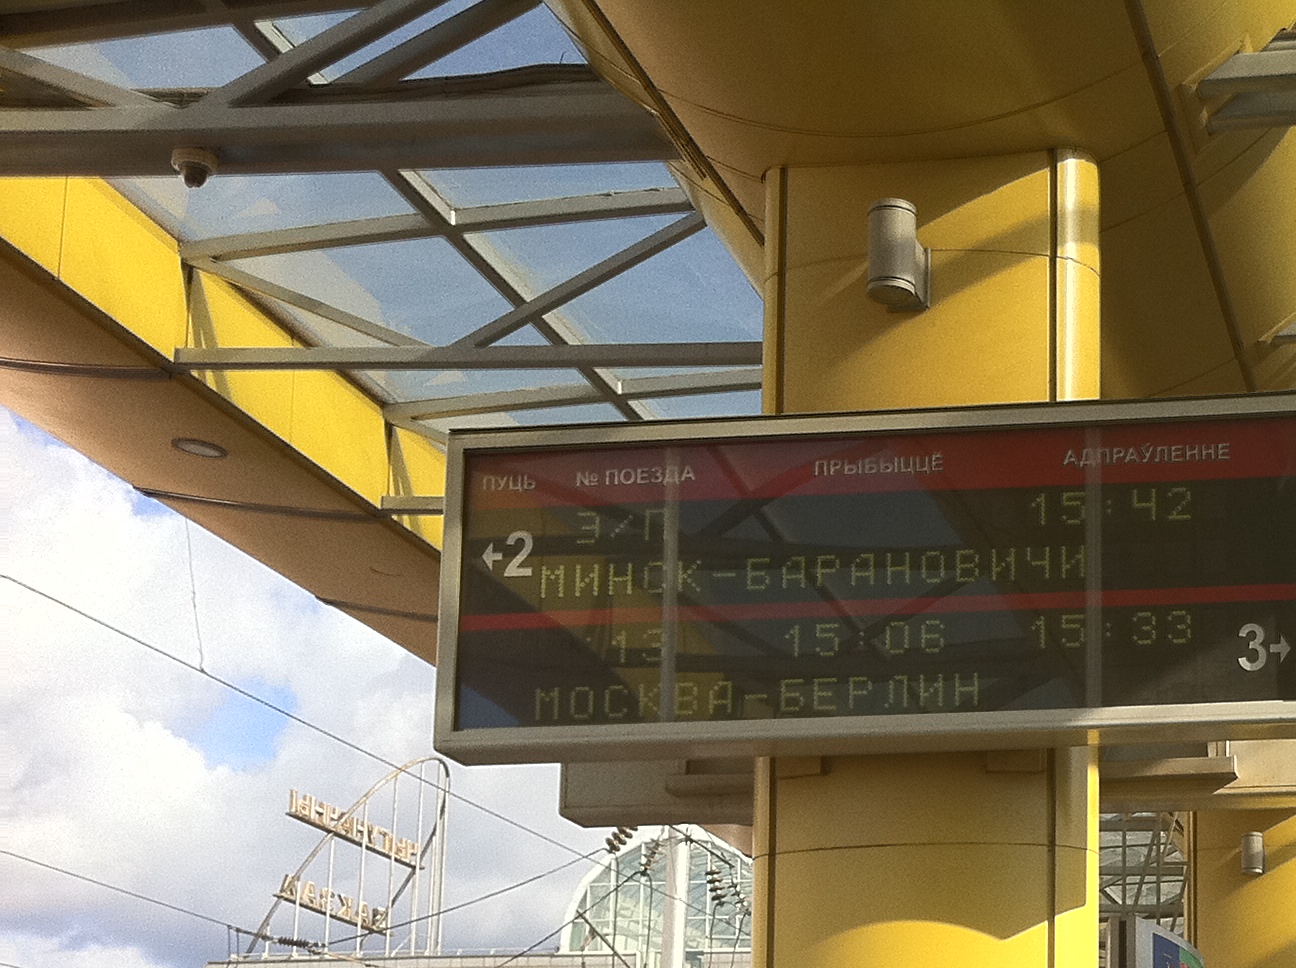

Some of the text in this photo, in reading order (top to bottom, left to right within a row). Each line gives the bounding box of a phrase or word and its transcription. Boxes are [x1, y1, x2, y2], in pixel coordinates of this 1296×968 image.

[483, 442, 1232, 492] ПУЦЬ № ПОЕЗДА ПРЫБЫЦЦЁ АДПРАЎЛЕННЕ
[1031, 487, 1193, 526] 15:42
[503, 530, 534, 578] 2
[541, 545, 1087, 599] МИНСК-БАРАНОВИЧИ
[785, 619, 947, 657] 15:06
[1031, 609, 1193, 649] 15:33
[1236, 623, 1268, 672] 3
[534, 674, 981, 720] МОСКВА-БЕРЛИН
